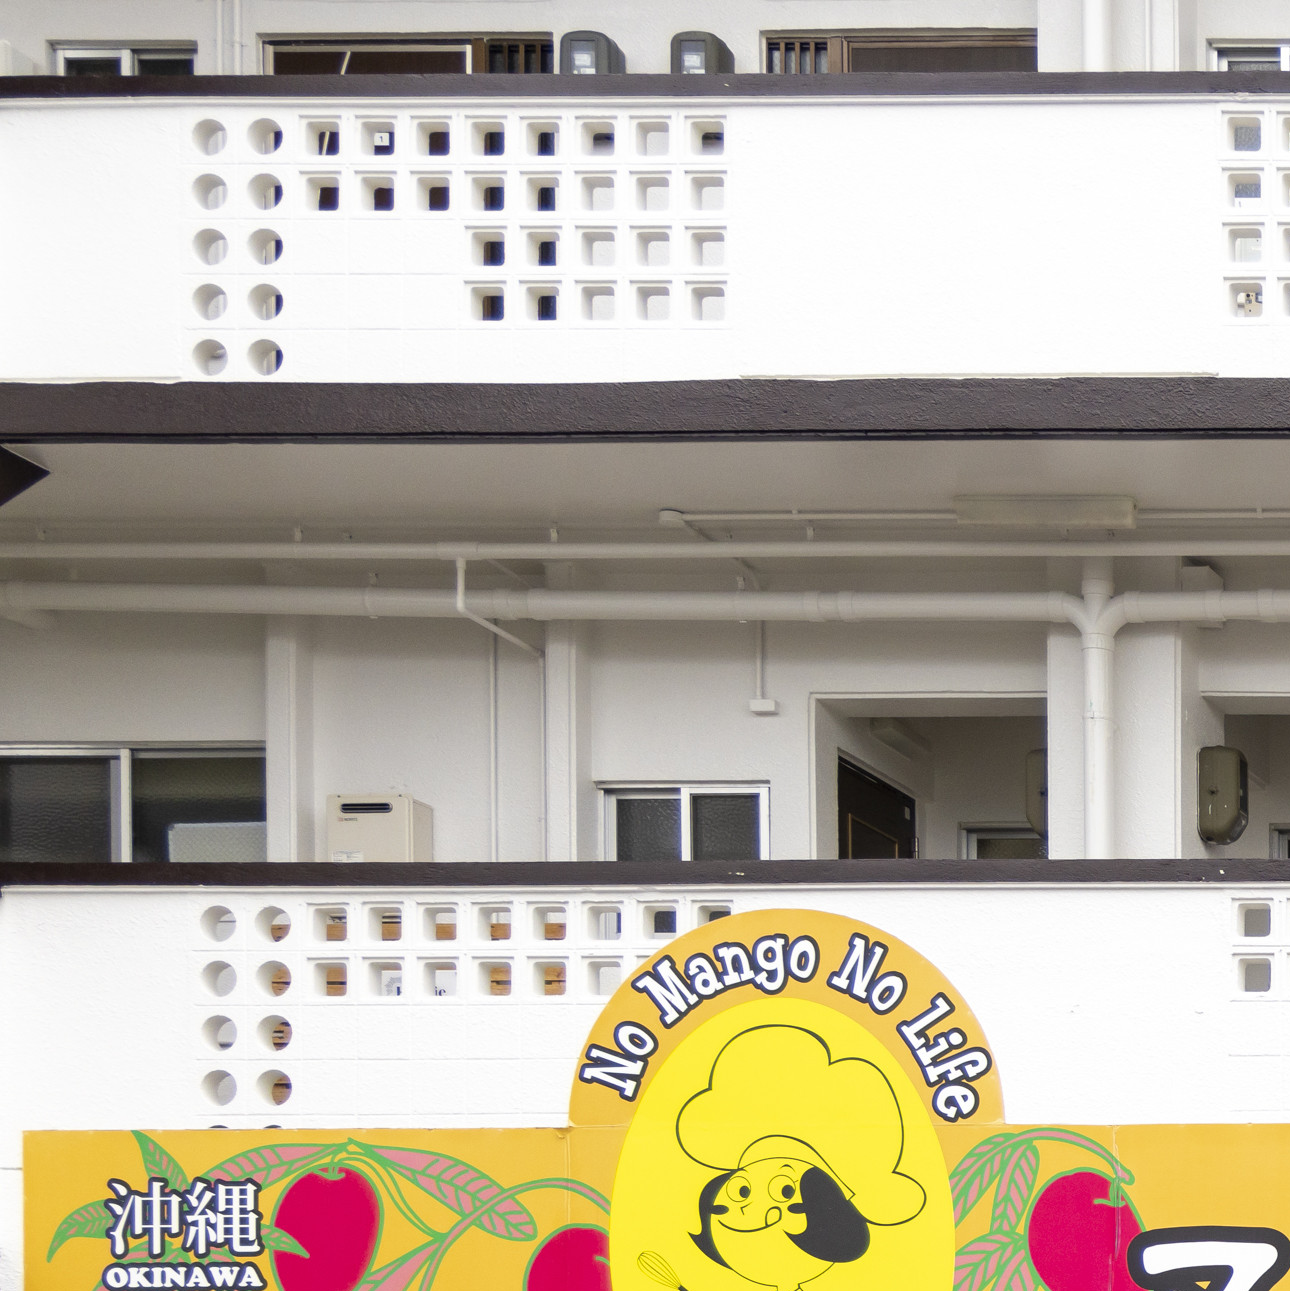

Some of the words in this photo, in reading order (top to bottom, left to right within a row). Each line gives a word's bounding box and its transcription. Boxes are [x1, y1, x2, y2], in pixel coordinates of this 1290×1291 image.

[582, 1019, 660, 1102] No
[631, 932, 820, 1030] Mango
[827, 932, 907, 1016] No
[896, 992, 992, 1123] Life
[105, 1176, 264, 1260] 沖縄
[101, 1262, 267, 1291] OKINAWA
